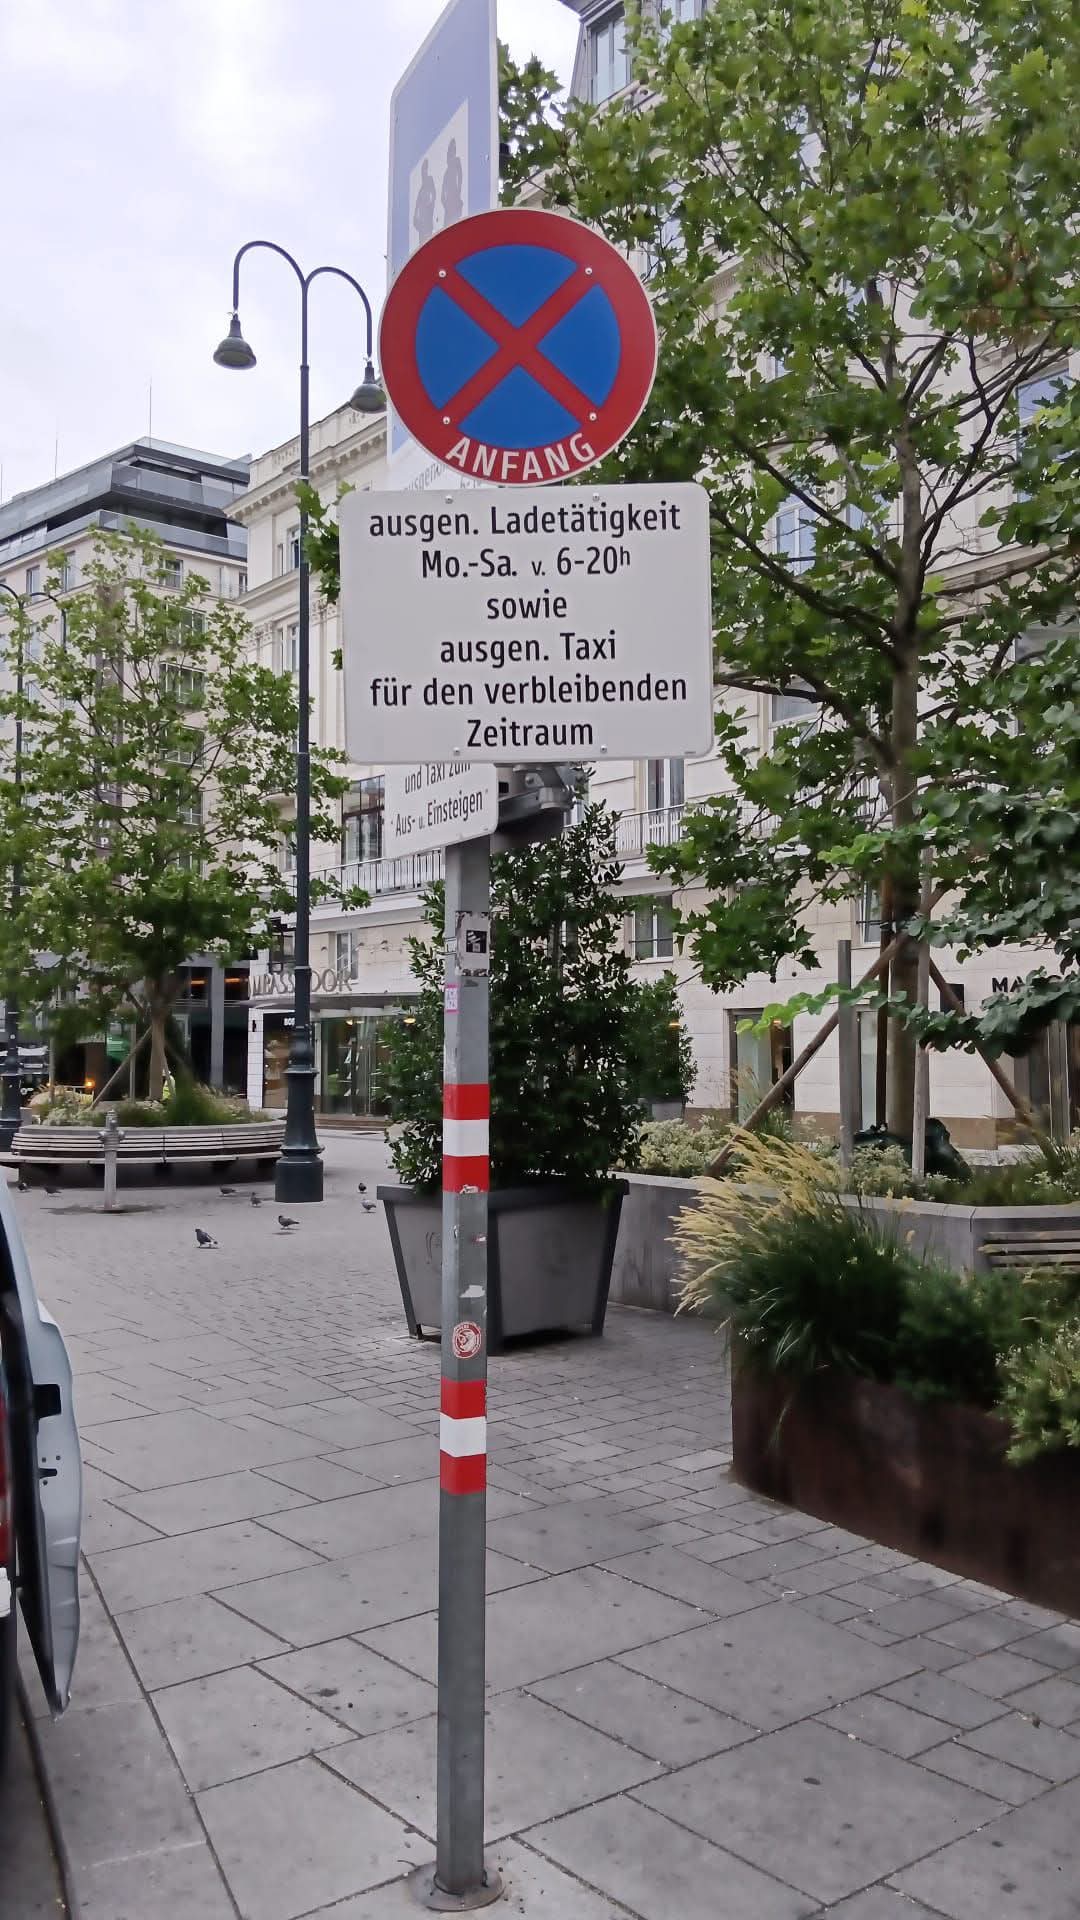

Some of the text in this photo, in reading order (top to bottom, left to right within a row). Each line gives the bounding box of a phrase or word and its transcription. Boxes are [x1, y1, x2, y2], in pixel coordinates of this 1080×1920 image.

[445, 432, 596, 482] ANFANG
[369, 500, 681, 542] ausgen. Ladetätigkeit
[422, 545, 631, 579] Mo.-Sa. v. 6-20h
[486, 588, 567, 620] sowie
[440, 629, 616, 669] ausgen. Taxi
[369, 672, 687, 707] für den verbleibenden
[467, 716, 594, 748] Zeitraum
[395, 813, 416, 837] Aus-
[427, 790, 483, 827] Einsteigen
[248, 968, 353, 998] MBASSDOR
[991, 975, 1026, 993] MA
